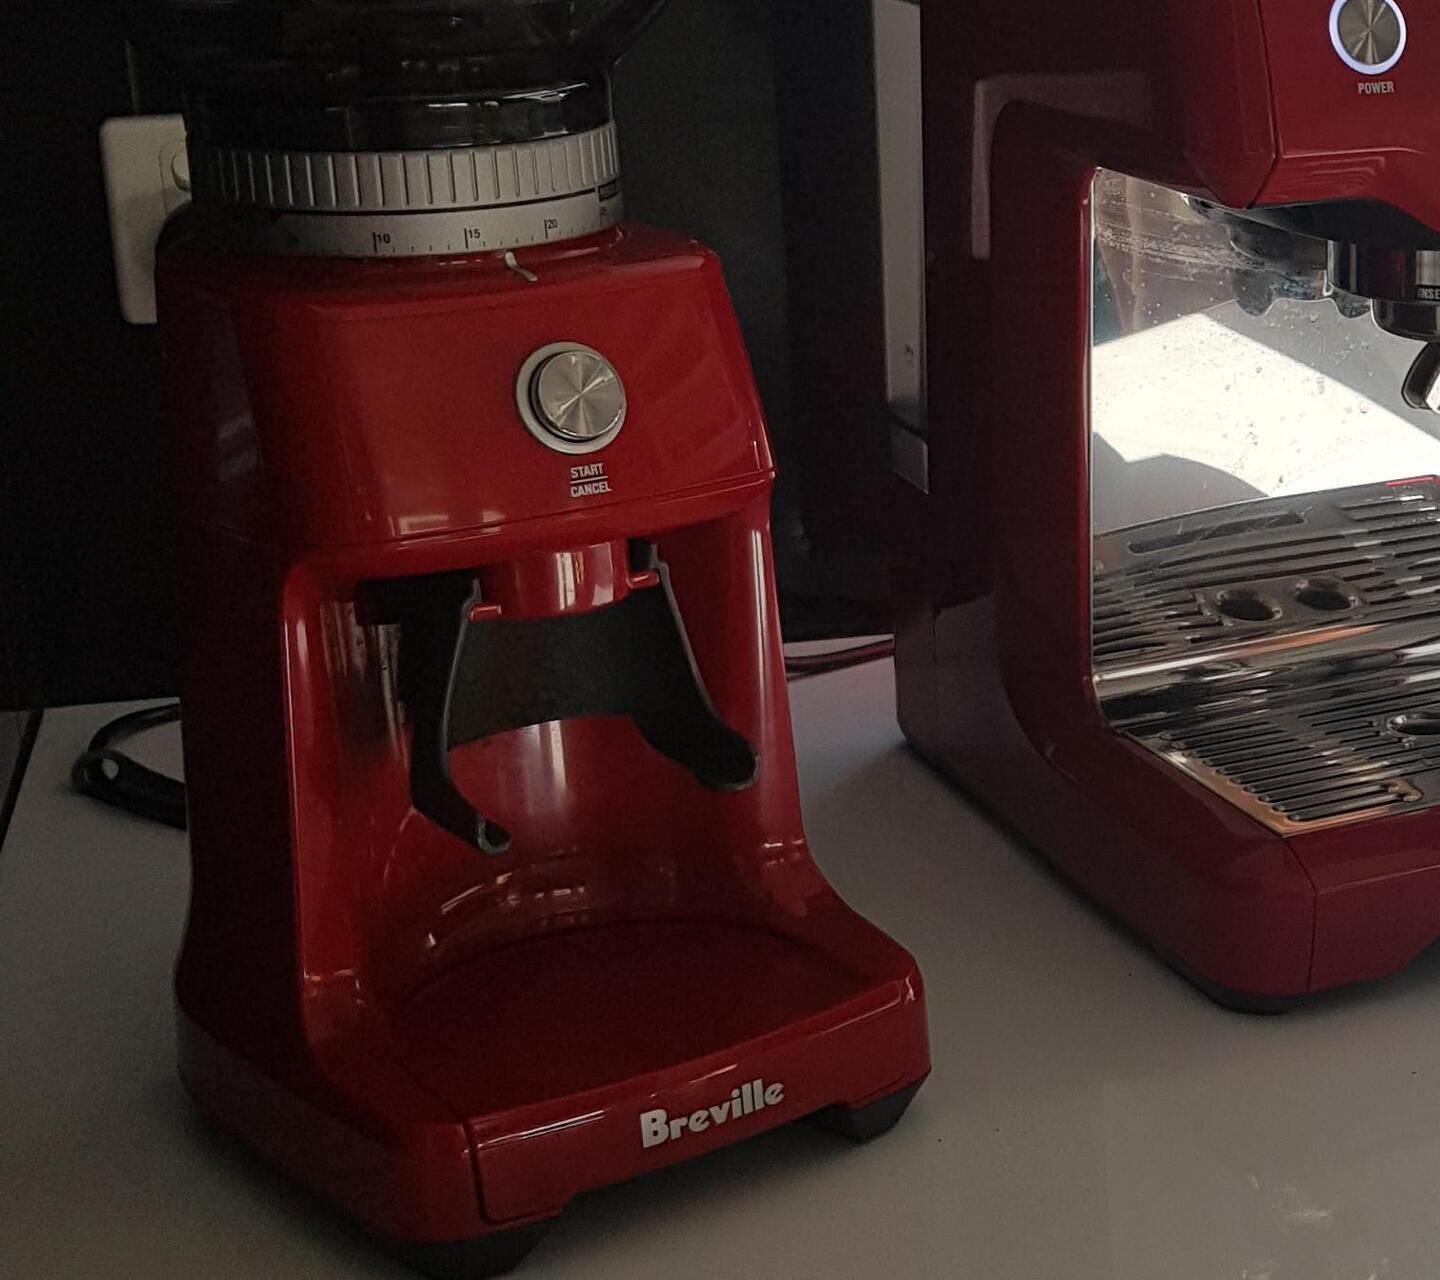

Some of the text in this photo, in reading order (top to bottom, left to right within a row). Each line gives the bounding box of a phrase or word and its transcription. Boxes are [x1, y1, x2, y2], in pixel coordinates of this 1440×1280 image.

[1357, 80, 1395, 95] POWER
[376, 219, 558, 245] 10 15 20
[570, 462, 604, 479] START
[570, 480, 613, 498] CANCEL
[639, 1078, 785, 1149] Breville
